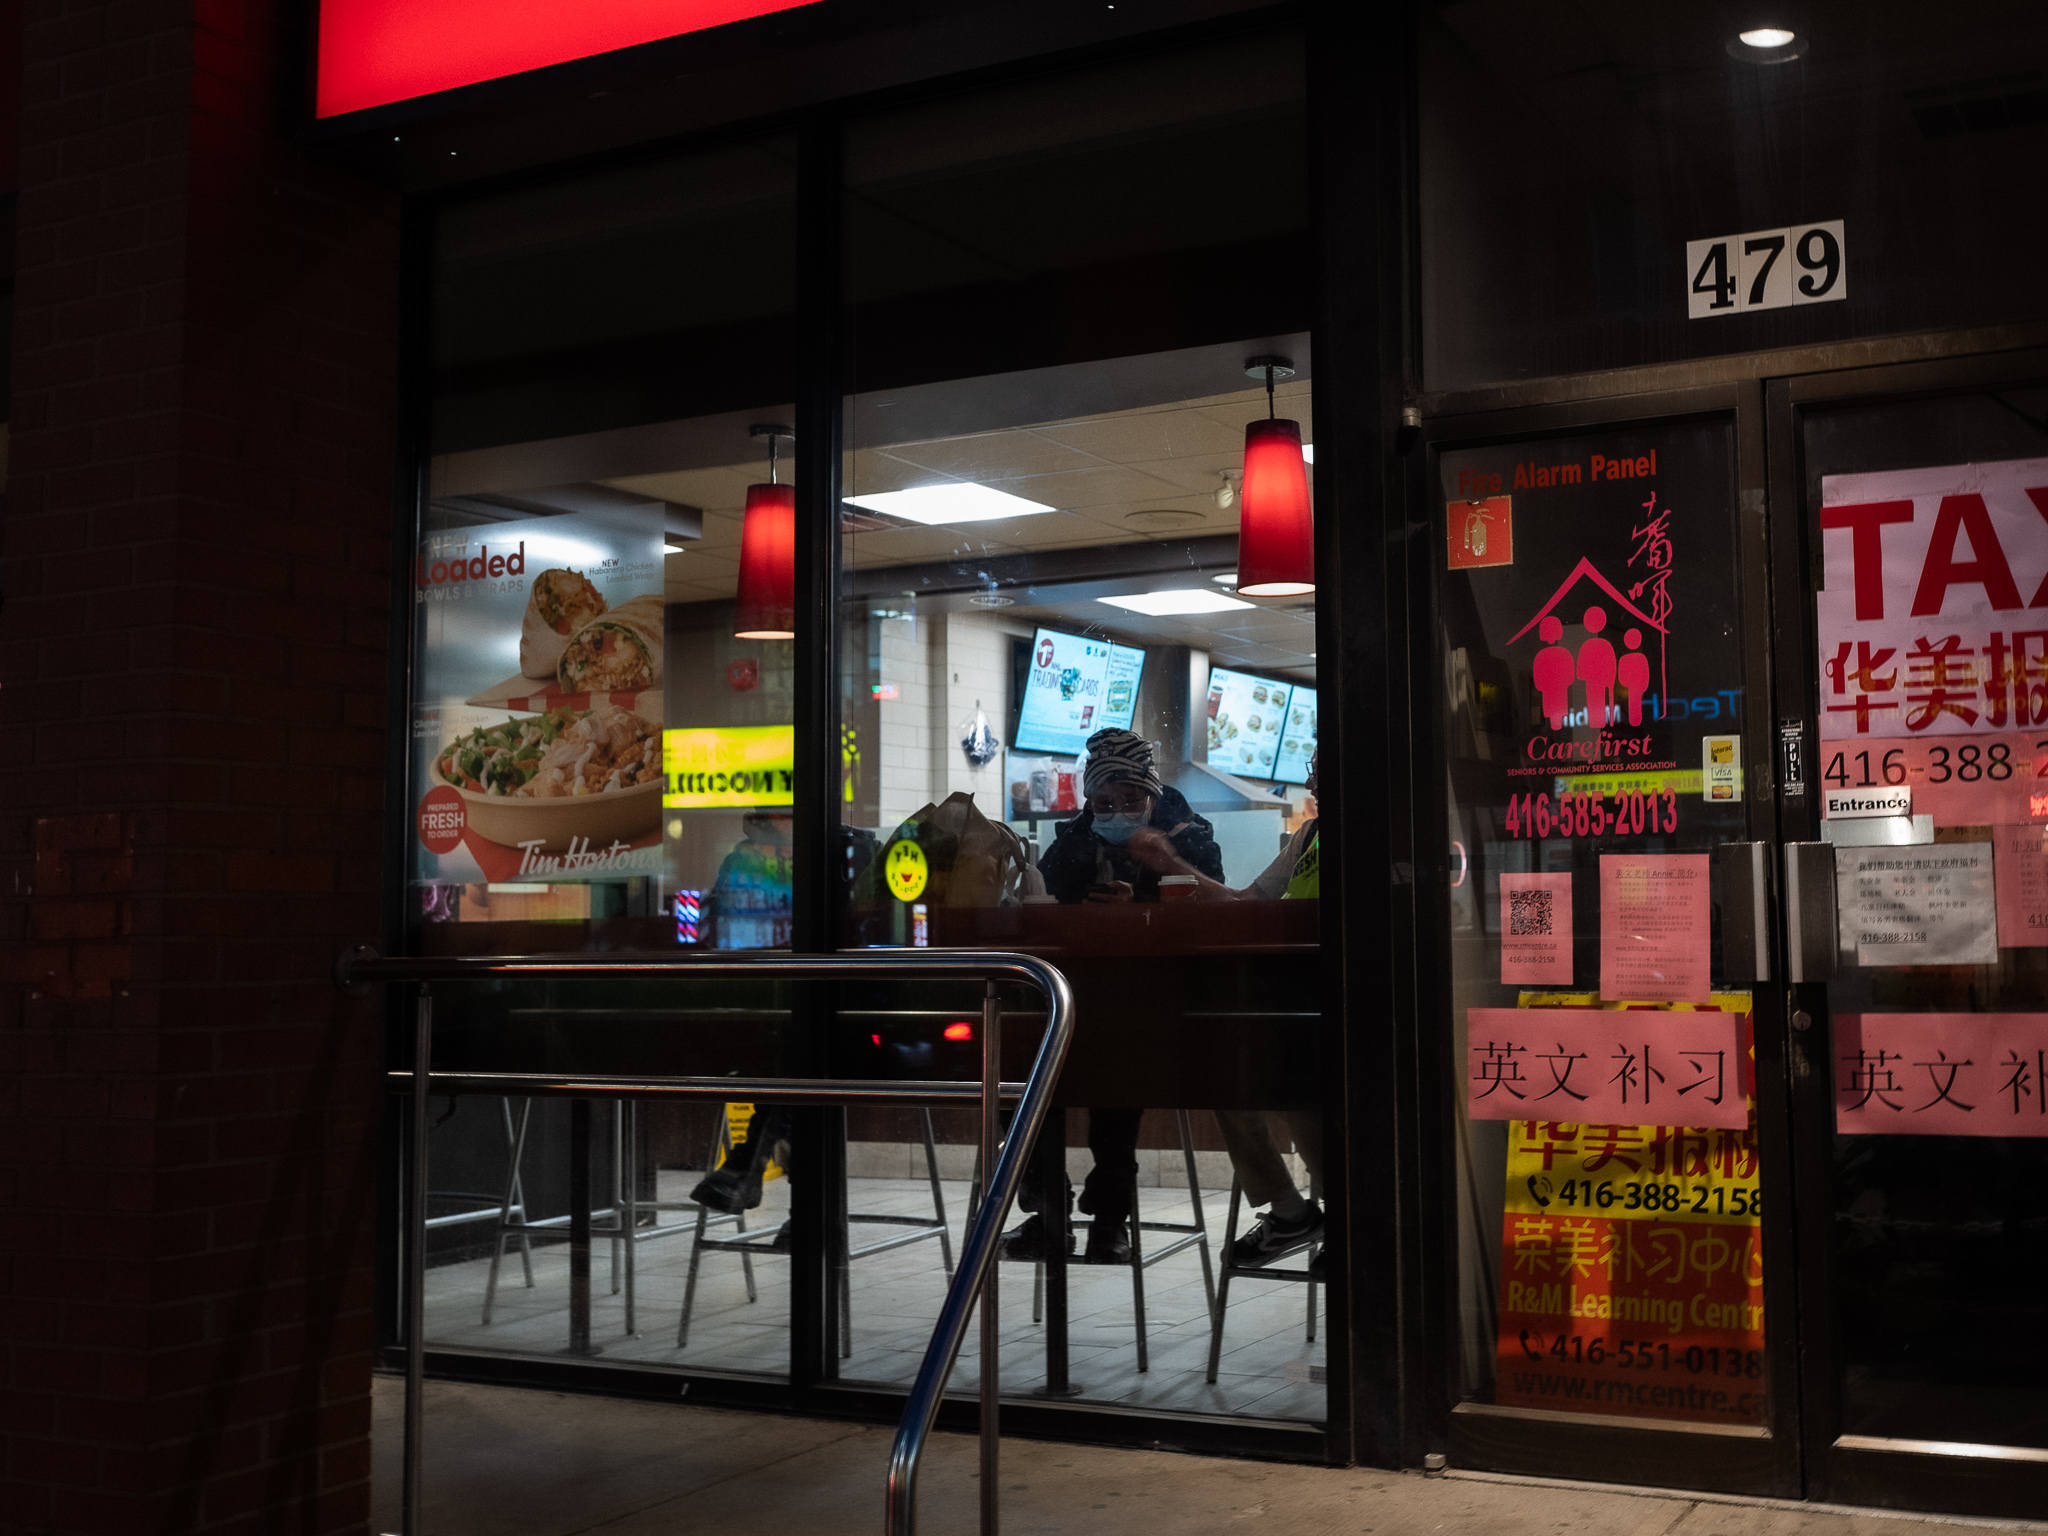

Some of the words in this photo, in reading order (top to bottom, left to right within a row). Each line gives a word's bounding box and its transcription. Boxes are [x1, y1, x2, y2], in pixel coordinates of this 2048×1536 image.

[1692, 229, 1840, 310] 479
[1458, 469, 1502, 496] Fire
[1513, 461, 1581, 490] Alarm
[1591, 449, 1657, 482] Panel
[602, 558, 619, 568] NEW
[1819, 486, 2048, 621] TA
[416, 541, 525, 587] Loaded
[589, 566, 625, 576] Habanero
[626, 562, 654, 571] Chicken
[606, 574, 633, 583] Loaded
[634, 572, 654, 582] Wrap
[416, 585, 460, 604] BOWLS
[1527, 731, 1653, 764] Carefirst
[1507, 767, 1538, 777] SENIORS
[1546, 764, 1591, 775] COMMUNITY
[1591, 763, 1625, 773] SERVICES
[1625, 761, 1677, 771] ASSOCIATION
[1789, 743, 1797, 781] PULL
[1714, 769, 1733, 777] VISA
[427, 802, 459, 812] PREPARED
[1505, 787, 1678, 839] 416-585-2013
[1829, 797, 1908, 812] Entrance
[421, 811, 465, 831] FRESH
[427, 829, 436, 839] TO
[436, 829, 459, 839] ORDER
[517, 839, 560, 876] Tim
[1652, 869, 1673, 878] Annie
[1861, 932, 1927, 943] 416-388-2158
[1508, 956, 1556, 964] 416-388-2158
[1473, 1041, 1725, 1106] 英文补习
[1507, 1279, 1563, 1316] R&M
[1569, 1283, 1684, 1334] Learning
[1551, 1334, 1762, 1380] 416-551-0138
